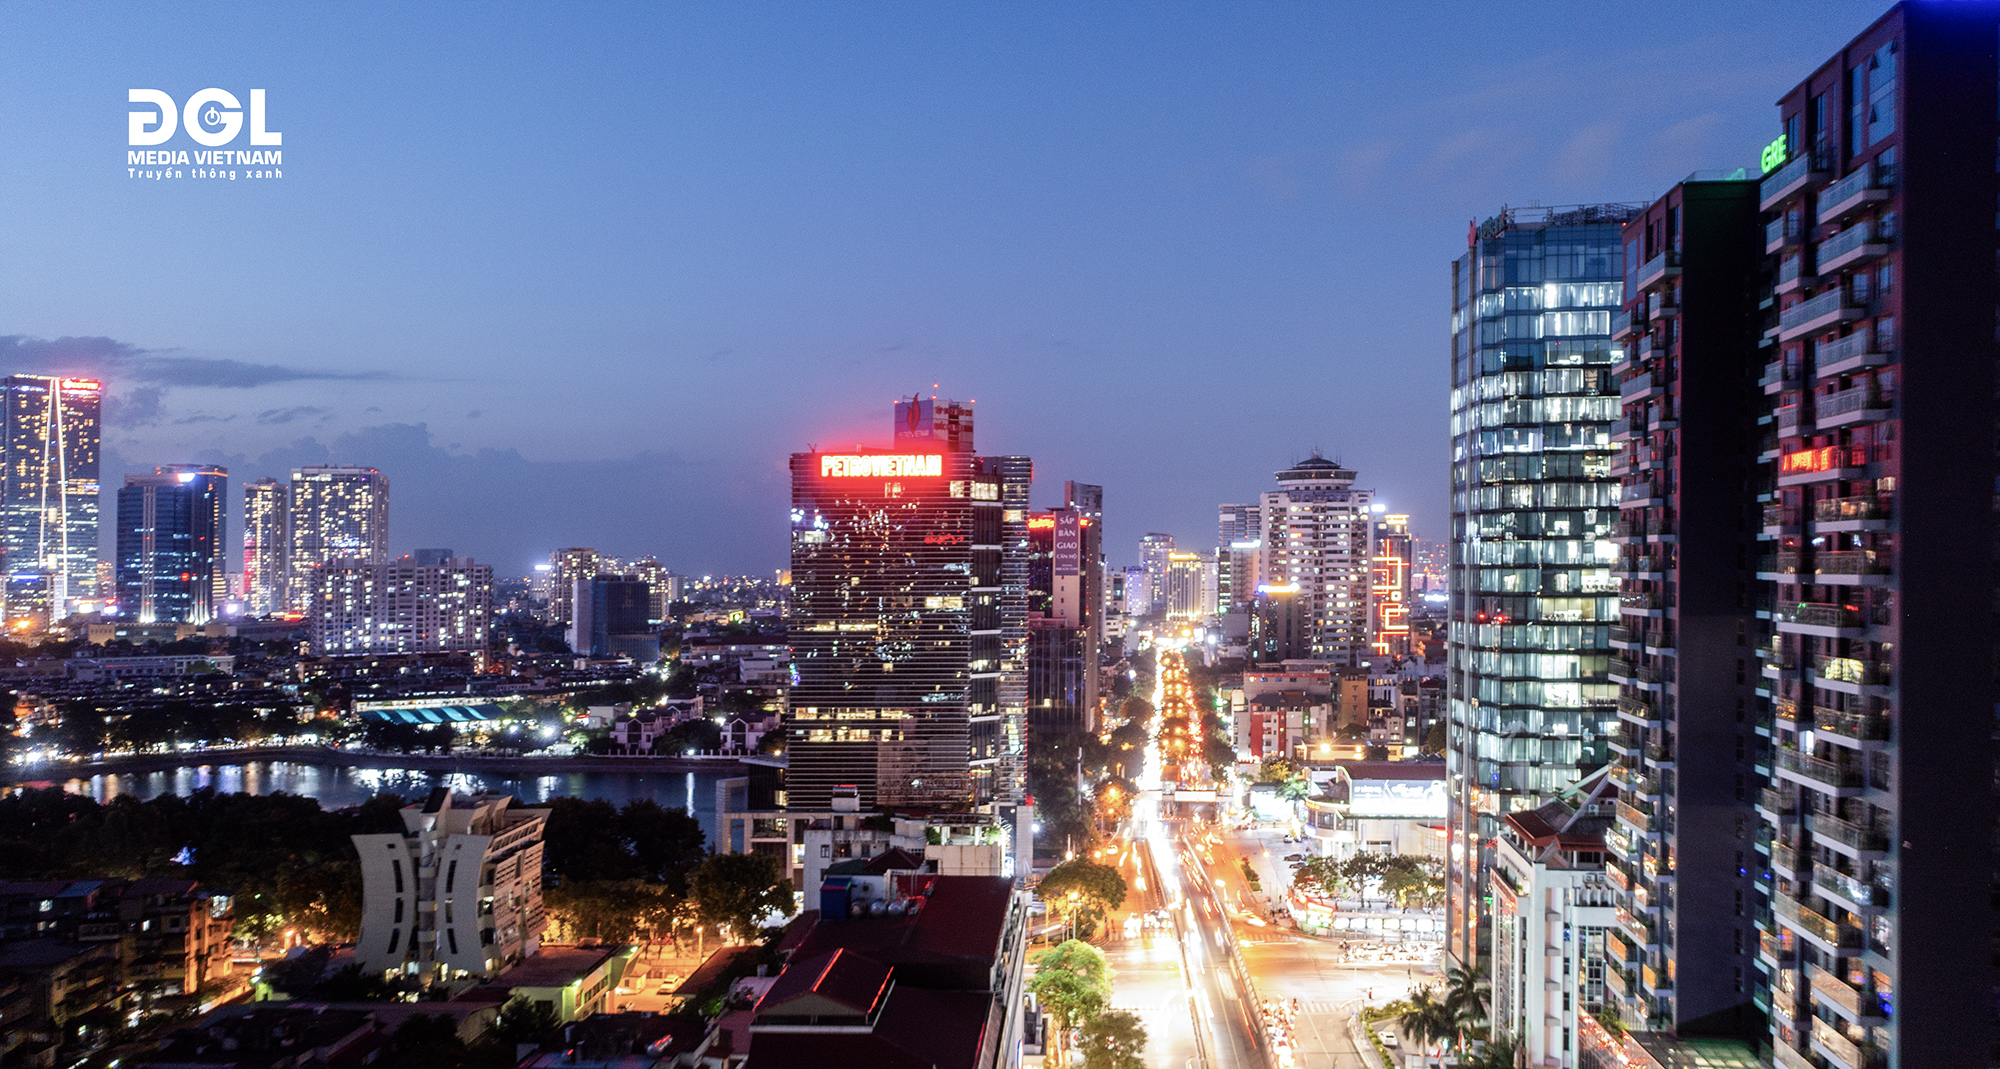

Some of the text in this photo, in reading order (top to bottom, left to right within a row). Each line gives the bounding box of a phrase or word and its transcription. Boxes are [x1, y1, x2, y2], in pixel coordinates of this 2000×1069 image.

[821, 455, 942, 477] PETROVIETNAM
[1059, 515, 1075, 524] SẮP
[1058, 527, 1076, 537] BÀN
